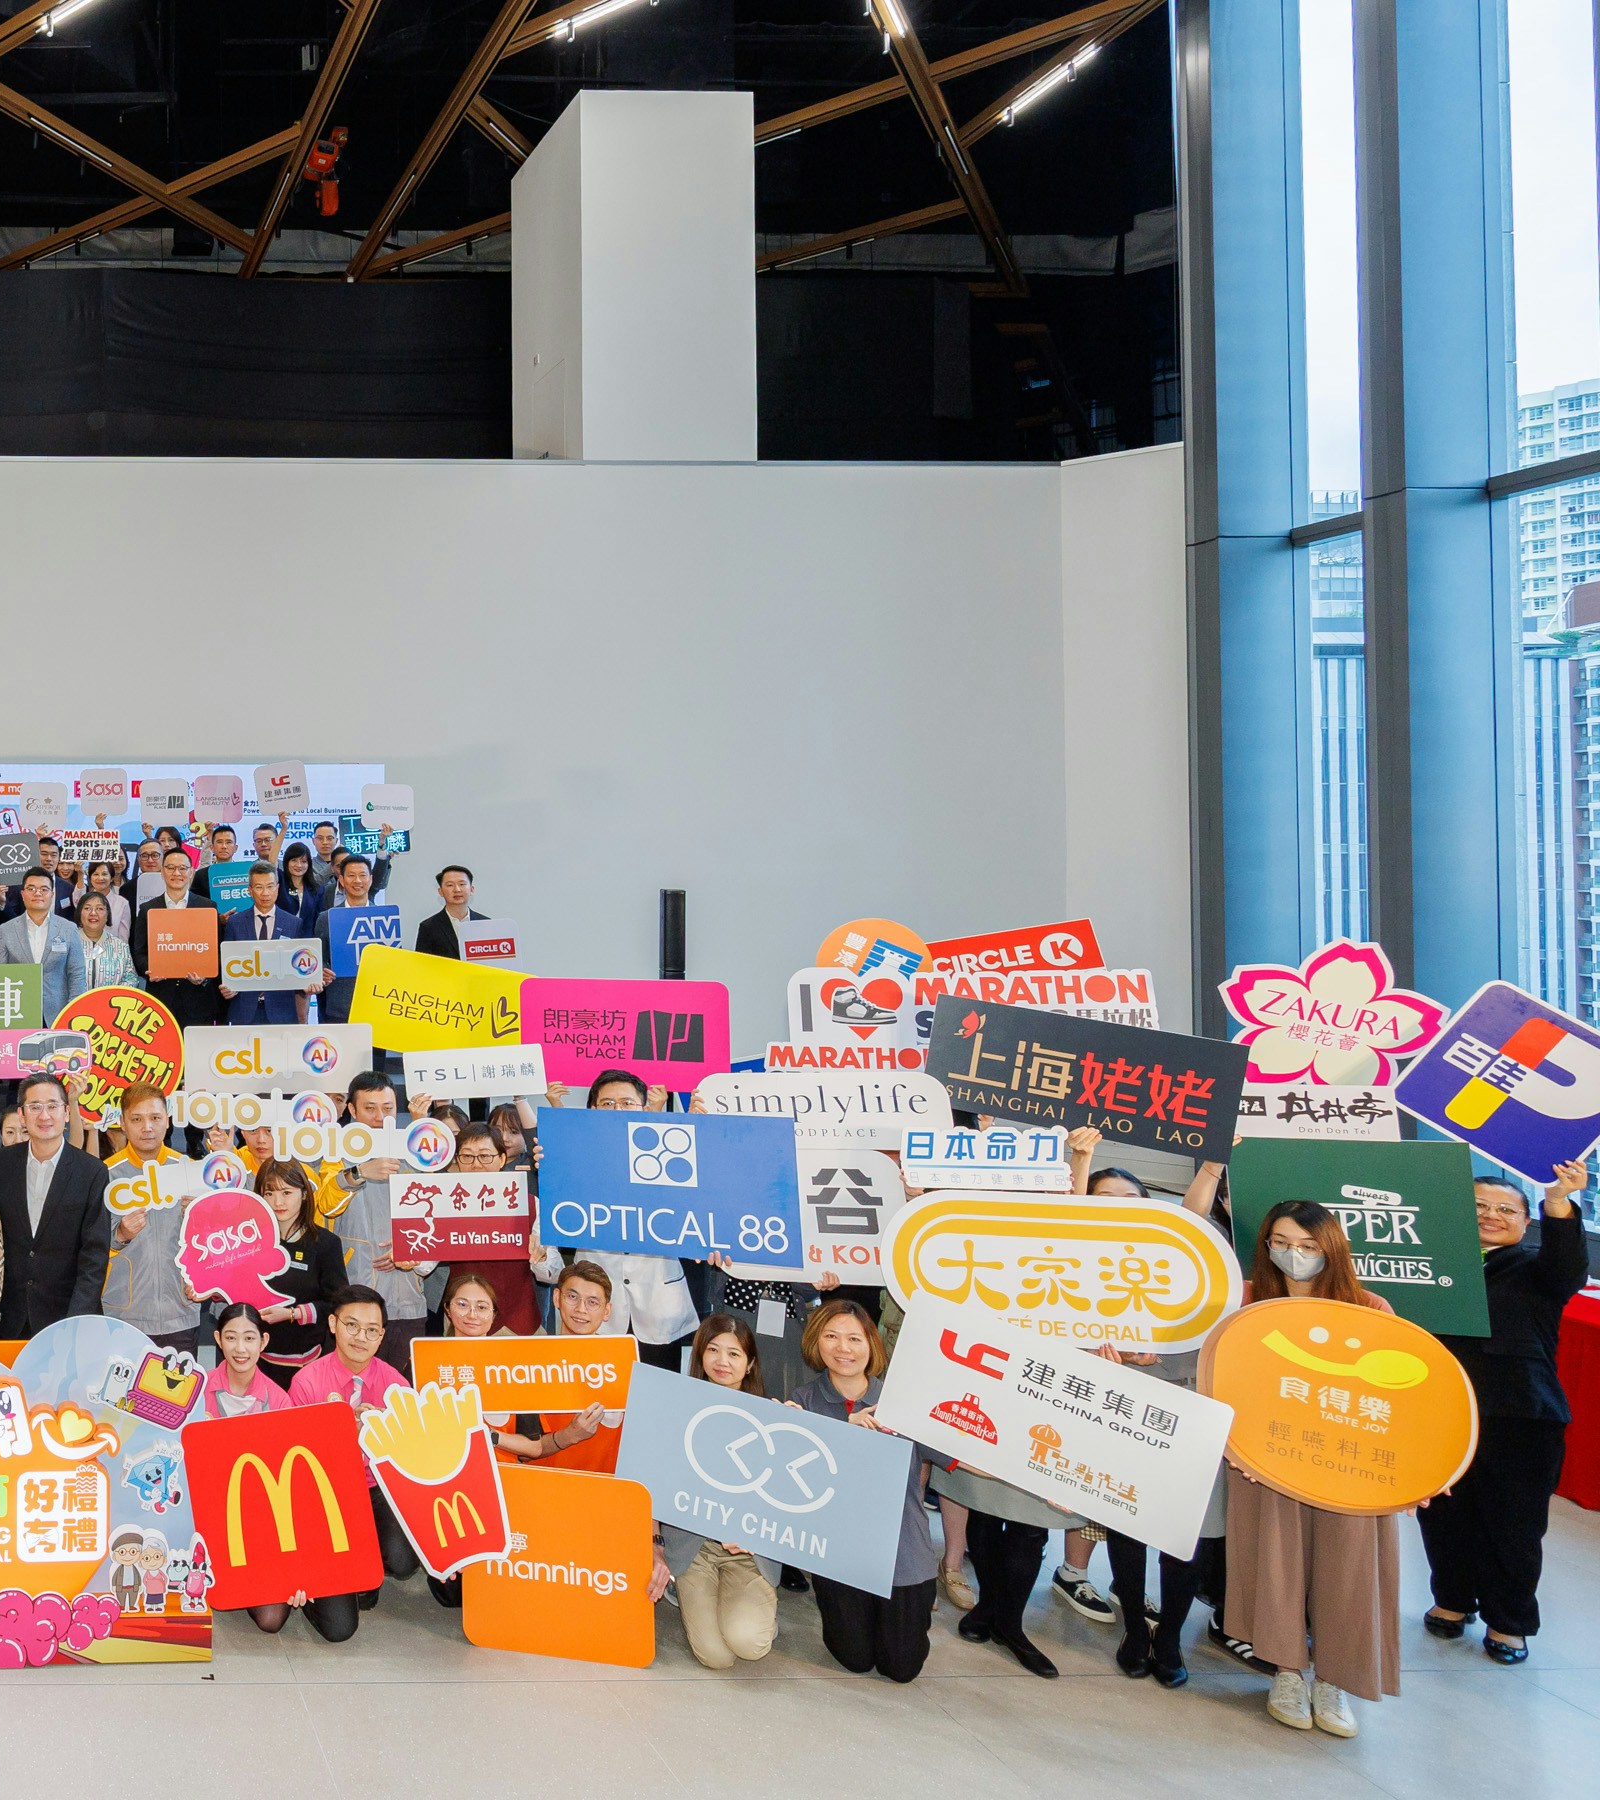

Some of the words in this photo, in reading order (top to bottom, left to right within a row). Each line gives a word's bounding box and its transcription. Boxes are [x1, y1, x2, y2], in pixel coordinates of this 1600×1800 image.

[64, 831, 118, 839] MARATHON
[345, 834, 406, 854] 謝瑞麟
[62, 849, 118, 861] 最強團隊
[157, 941, 209, 953] mannings
[469, 944, 498, 954] CIRCLE
[833, 932, 867, 967] 豐澤
[933, 944, 1034, 974] CIRCLE
[297, 958, 311, 968] AI
[372, 984, 485, 1019] LANGHAM
[915, 975, 1149, 1006] MARATHON
[109, 996, 165, 1044] THE
[388, 1002, 481, 1032] BEAUTY
[543, 1008, 627, 1031] 朗豪坊
[1258, 989, 1400, 1041] ZAKURA
[544, 1032, 626, 1047] LANGHAM
[1286, 1022, 1360, 1052] 櫻花薈
[311, 1049, 328, 1062] AI
[576, 1047, 626, 1060] PLACE
[481, 1062, 536, 1081] 謝瑞麟
[947, 1032, 1215, 1129] 上海姥姥
[177, 1095, 261, 1126] 1010
[302, 1108, 321, 1122] AI
[715, 1083, 929, 1123] simplylife
[946, 1084, 1066, 1121] SHANGHAI
[1086, 1111, 1134, 1135] LAO
[1155, 1126, 1205, 1148] LAO
[278, 1127, 373, 1158] 1010
[418, 1137, 438, 1152] AI
[1299, 1126, 1321, 1134] Don
[1327, 1127, 1349, 1135] Don
[1354, 1127, 1370, 1135] Tei
[906, 1131, 1058, 1162] 日本命力
[213, 1168, 232, 1182] AI
[909, 1172, 1067, 1187] 日本命力健康食品
[450, 1180, 520, 1211] 余仁生
[1352, 1188, 1390, 1202] oliver's
[450, 1232, 466, 1246] Eu
[467, 1231, 490, 1245] Yan
[491, 1230, 523, 1247] Sang
[551, 1201, 731, 1250] OPTICAL
[738, 1213, 789, 1255] 88
[1039, 1320, 1067, 1337] DE
[1072, 1322, 1149, 1343] CORAL
[437, 1364, 475, 1386] 萬寧
[484, 1359, 618, 1389] mannings
[1021, 1357, 1179, 1438] 建華集團
[1279, 1376, 1393, 1425] 食得樂
[951, 1403, 985, 1424] 香港街市
[1017, 1384, 1104, 1426] UNI-CHINA
[1108, 1421, 1171, 1450] GROUP
[1320, 1409, 1359, 1429] TASTE
[1362, 1419, 1389, 1436] JOY
[1265, 1442, 1305, 1464] Soft
[1311, 1452, 1397, 1487] Gourmet
[23, 1468, 99, 1513] 好禮
[1027, 1460, 1052, 1473] bao
[1054, 1473, 1077, 1487] dim
[1080, 1484, 1100, 1498] sin
[1103, 1494, 1139, 1515] seng
[674, 1490, 735, 1531] CITY
[741, 1512, 829, 1559] CHAIN
[486, 1557, 628, 1595] mannings
